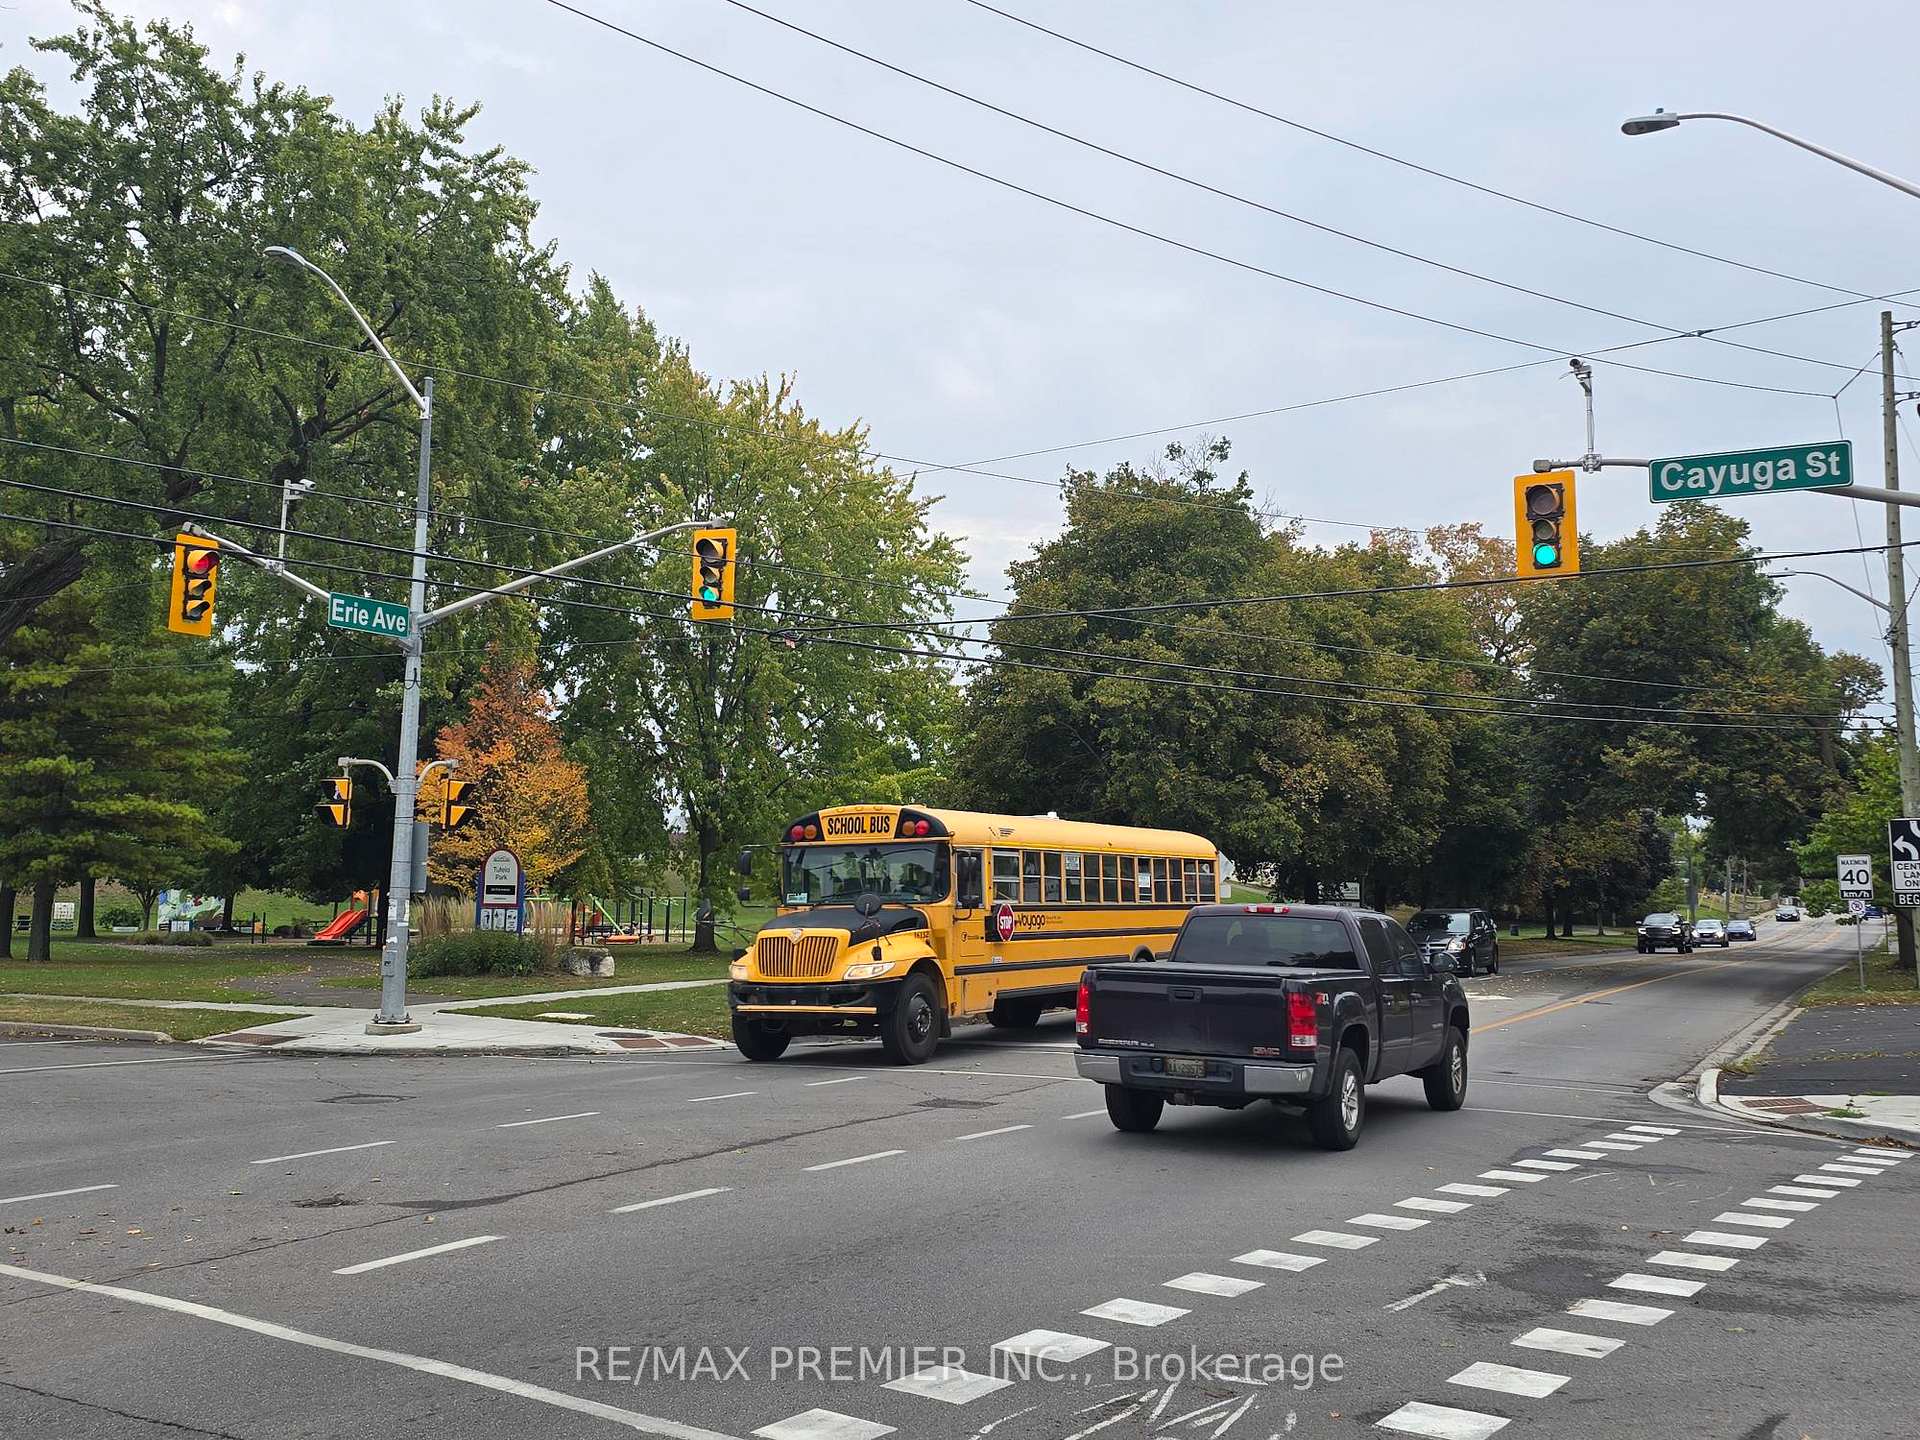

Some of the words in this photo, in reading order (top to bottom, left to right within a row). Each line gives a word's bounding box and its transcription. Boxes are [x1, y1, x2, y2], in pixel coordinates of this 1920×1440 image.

[1660, 457, 1796, 494] Cayuga
[1805, 451, 1841, 478] St
[331, 598, 369, 626] Erie
[372, 606, 406, 632] Ave
[827, 816, 867, 836] SCHOOL
[869, 815, 890, 834] BUS
[495, 873, 509, 881] Park
[1841, 869, 1870, 885] 40
[1842, 890, 1870, 898] km/h
[1898, 893, 1920, 905] BEG
[999, 915, 1013, 930] STOP
[1017, 913, 1046, 930] Voyago
